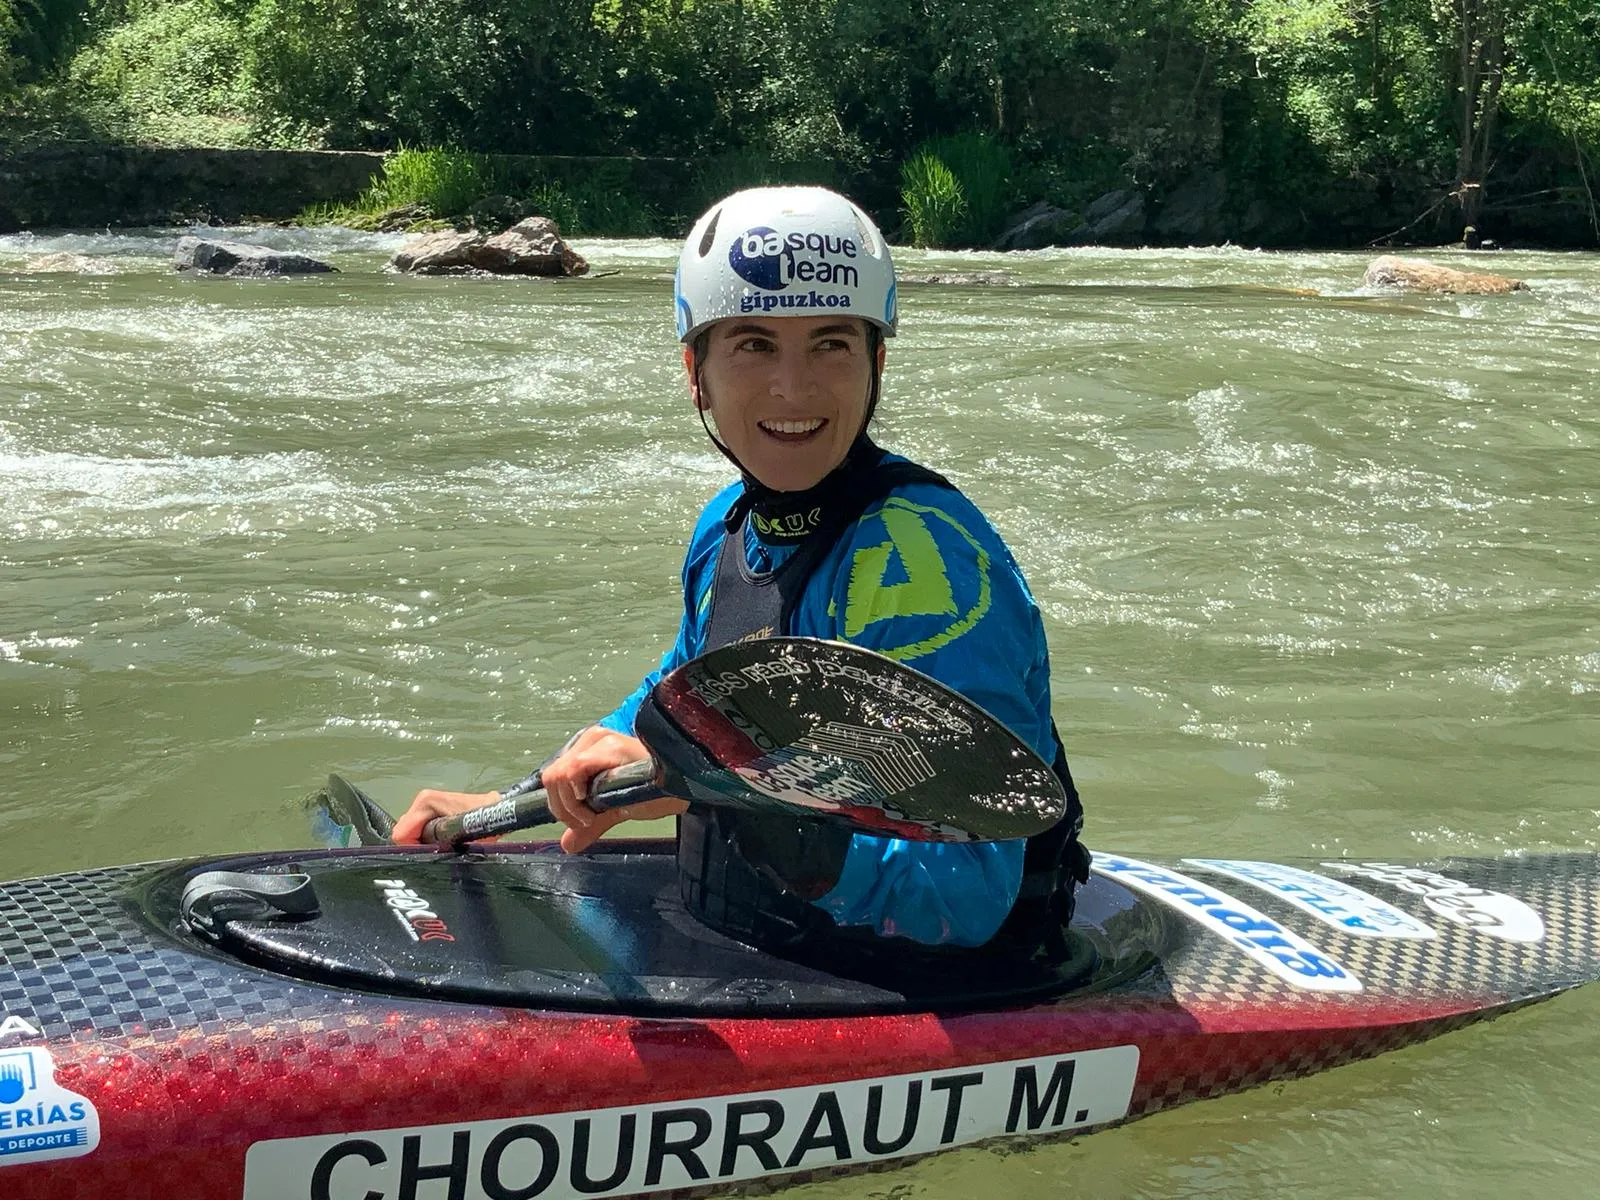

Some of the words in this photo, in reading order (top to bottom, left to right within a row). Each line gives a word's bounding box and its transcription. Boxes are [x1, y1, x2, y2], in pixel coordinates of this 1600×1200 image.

[740, 231, 857, 259] basque
[778, 253, 858, 288] team
[740, 291, 850, 313] gipuzkoa
[9, 1133, 71, 1150] DEPORTE
[310, 1072, 982, 1200] CHOURRAUT
[1006, 1058, 1091, 1135] M.
